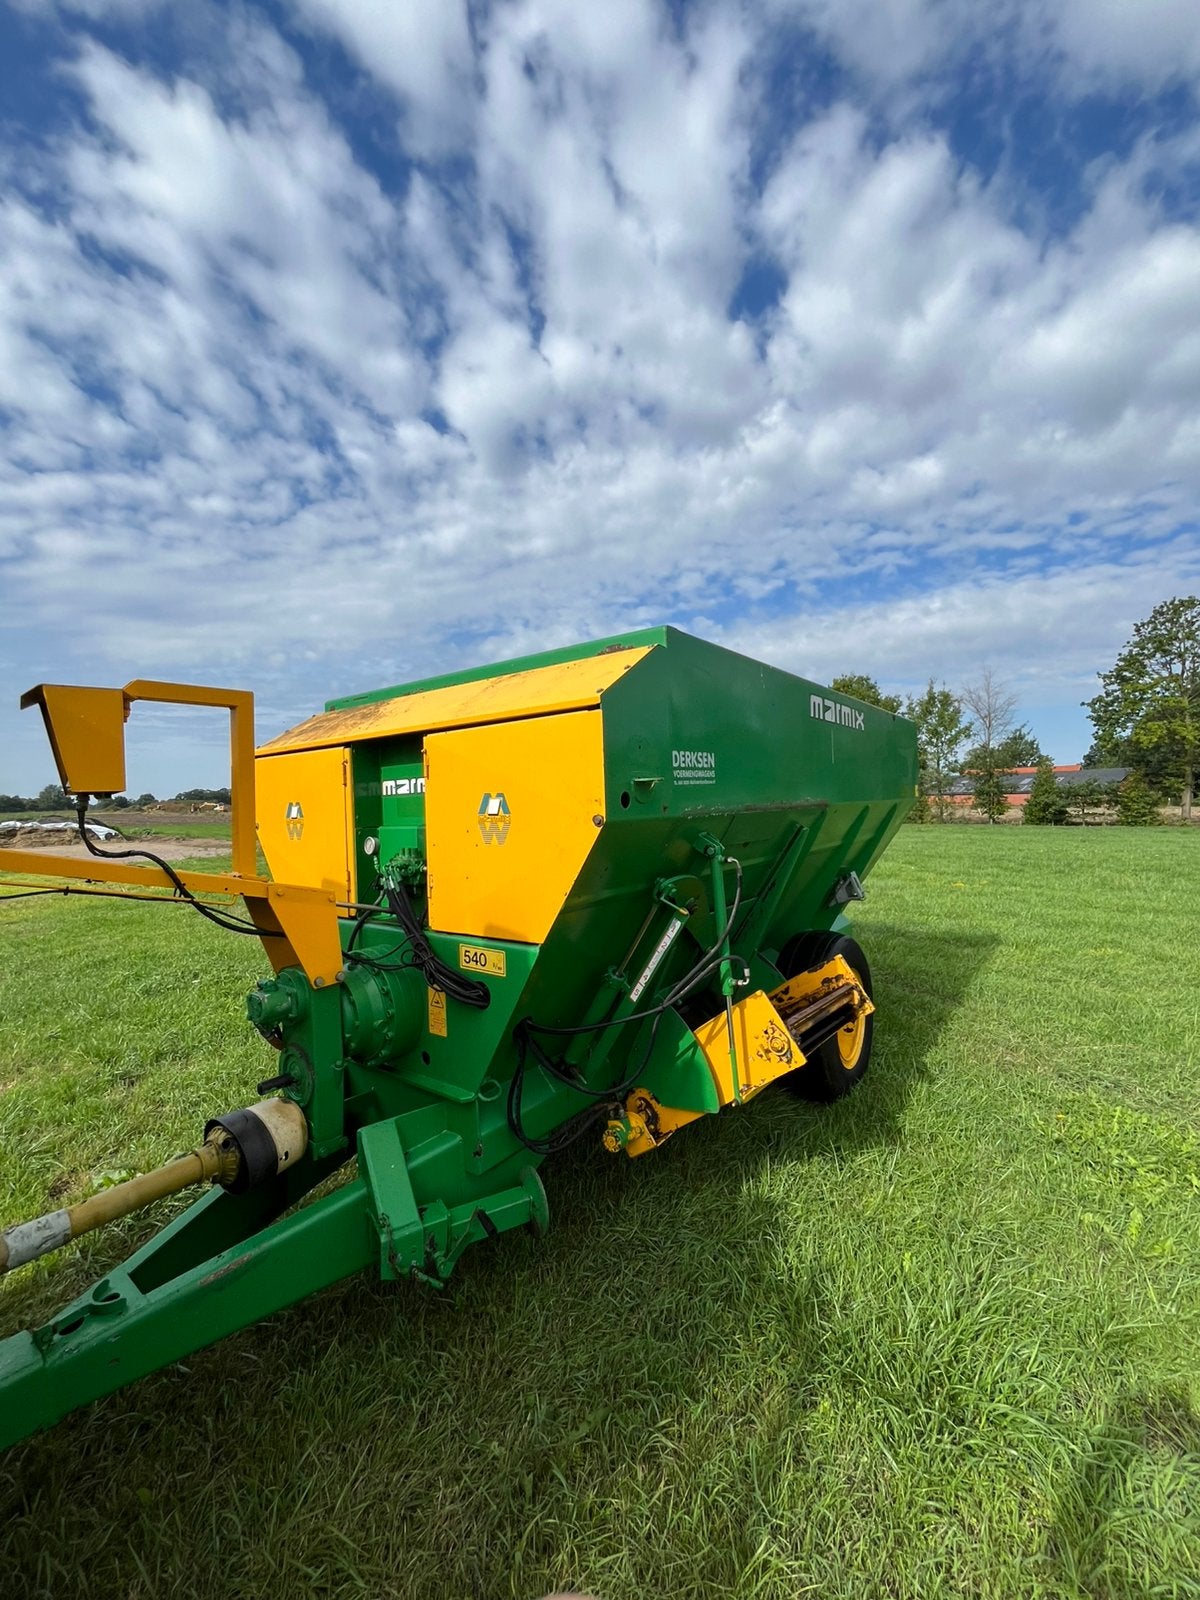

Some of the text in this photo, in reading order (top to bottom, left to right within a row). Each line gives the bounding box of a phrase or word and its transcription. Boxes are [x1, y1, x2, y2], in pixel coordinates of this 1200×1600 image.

[810, 694, 865, 731] marmix
[672, 750, 715, 768] DERKSEN
[463, 950, 487, 967] 540
